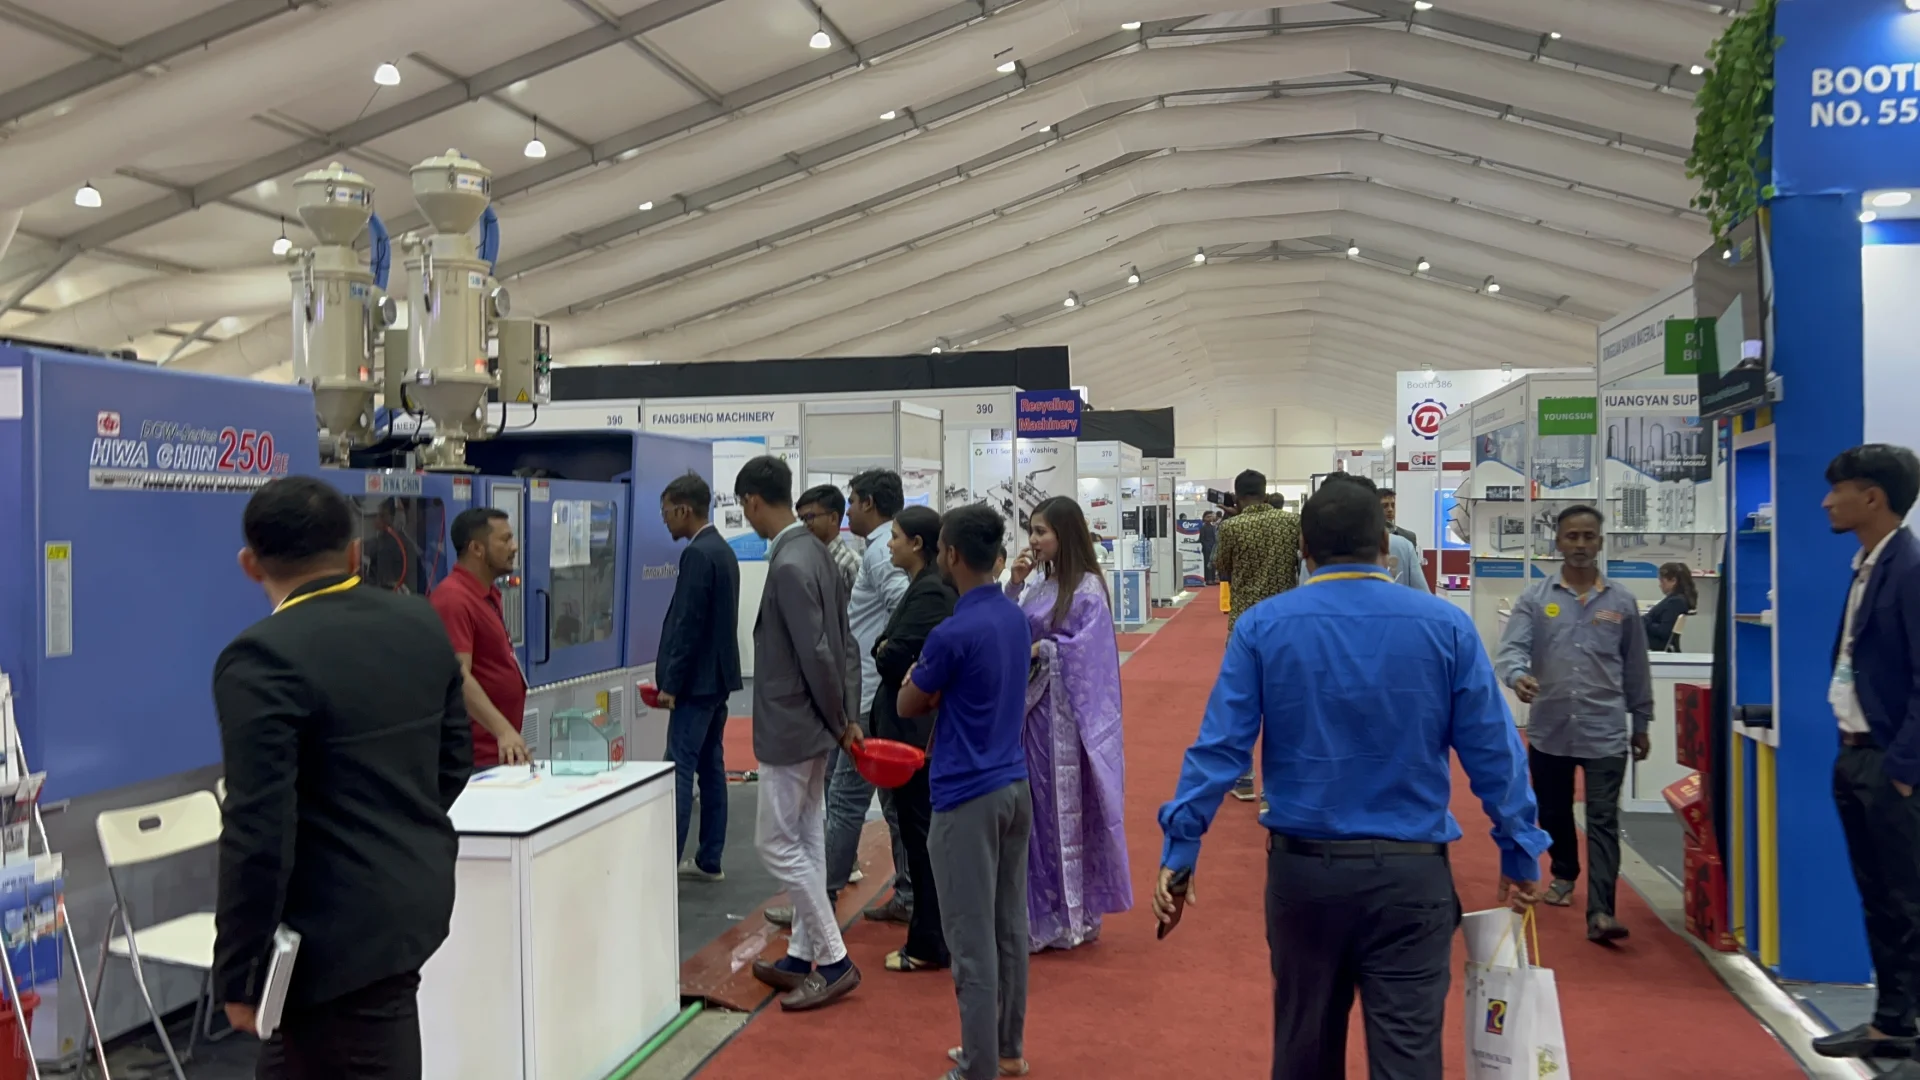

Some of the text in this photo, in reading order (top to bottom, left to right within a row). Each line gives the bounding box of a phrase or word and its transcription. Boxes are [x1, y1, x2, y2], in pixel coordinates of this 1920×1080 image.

[1811, 63, 1920, 97] BOOT
[1810, 98, 1920, 128] NO. 55
[1406, 381, 1453, 389] Booth 386
[976, 403, 994, 415] 390
[1020, 398, 1075, 414] Recycling
[606, 415, 623, 426] 390
[652, 411, 776, 425] FANGSHENG MACHINERY
[1018, 416, 1078, 433] Machinery
[1544, 412, 1594, 421] YOUNGSUN
[90, 437, 149, 468] HWA
[157, 443, 217, 472] CHIN
[216, 425, 275, 474] 250
[1029, 446, 1059, 454] Washing
[142, 472, 216, 490] INJECTION
[383, 475, 420, 492] HWA CHIN
